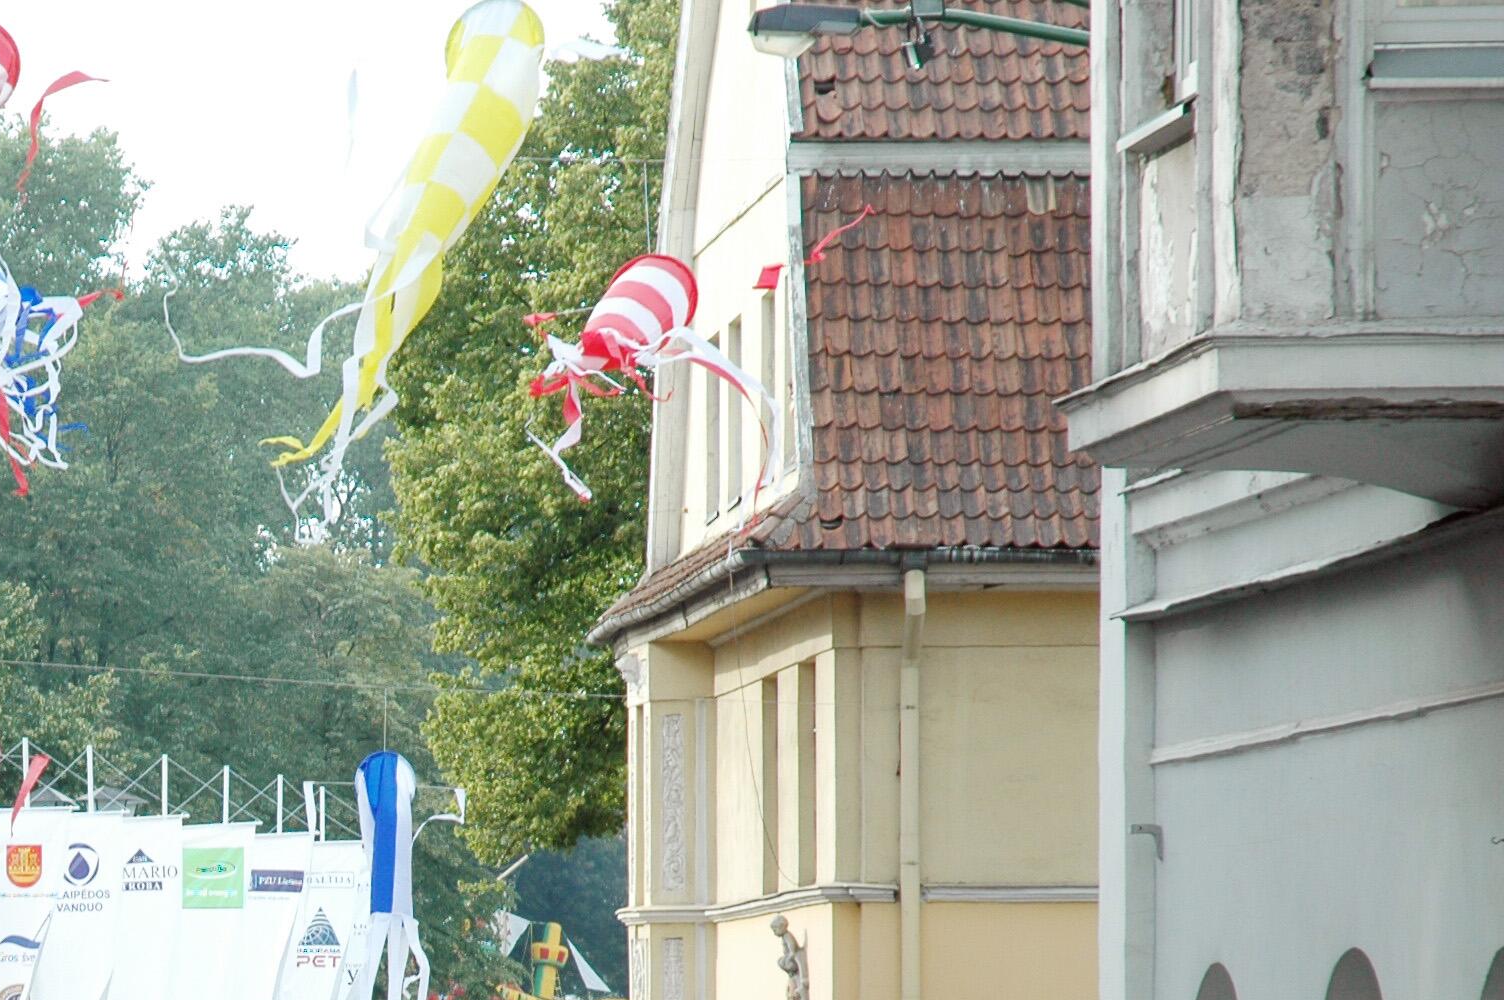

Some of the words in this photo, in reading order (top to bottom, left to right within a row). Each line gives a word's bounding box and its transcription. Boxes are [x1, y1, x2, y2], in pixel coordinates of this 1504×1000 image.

[122, 865, 178, 879] MARIO
[56, 902, 103, 912] VANDUO
[297, 956, 341, 968] PET
